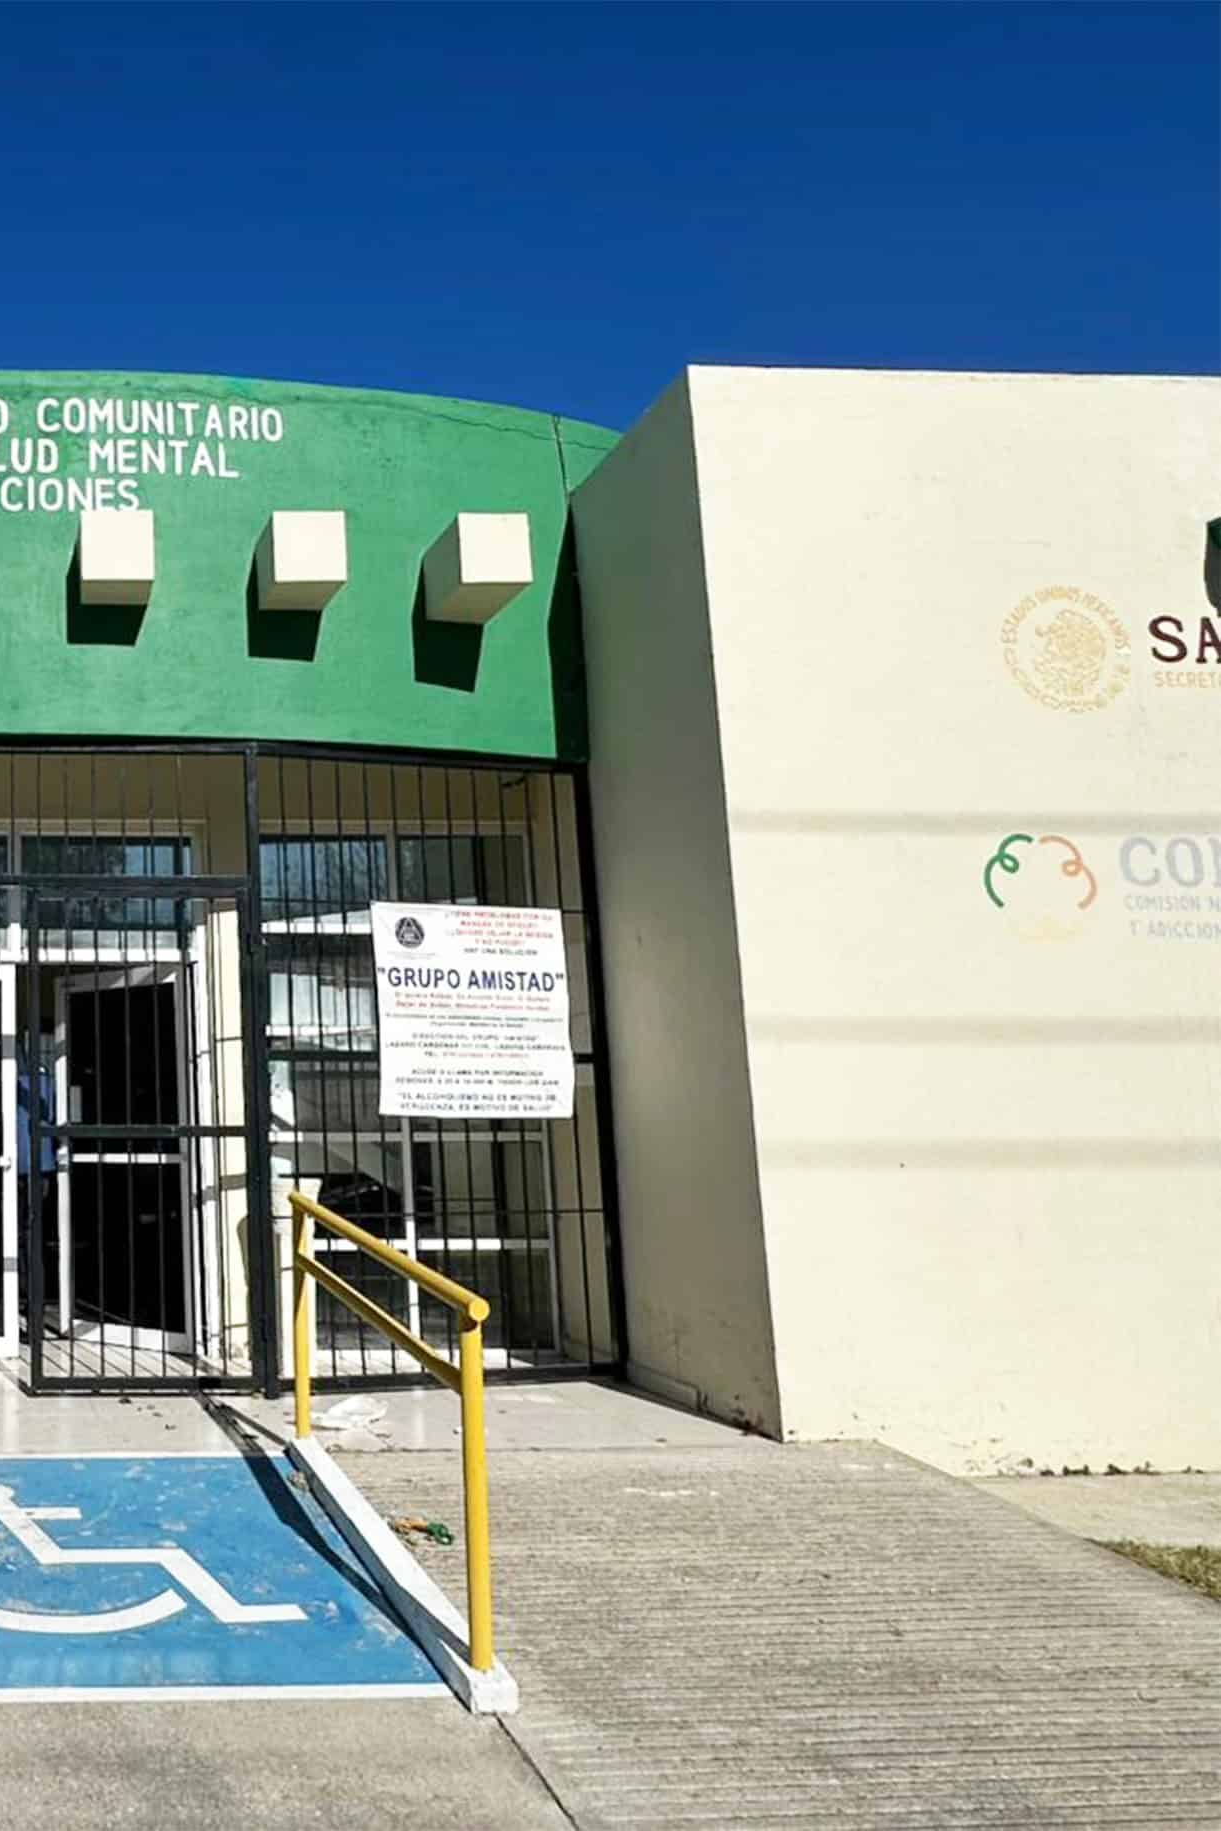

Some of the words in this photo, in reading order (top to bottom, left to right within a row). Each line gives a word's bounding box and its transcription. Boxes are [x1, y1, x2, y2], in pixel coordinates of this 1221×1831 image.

[36, 398, 284, 443] COMUNITARIO
[89, 440, 239, 478] MENTAL
[1154, 670, 1221, 688] SECRET
[377, 966, 461, 988] "GRUPO
[468, 970, 564, 992] AMISTAD"
